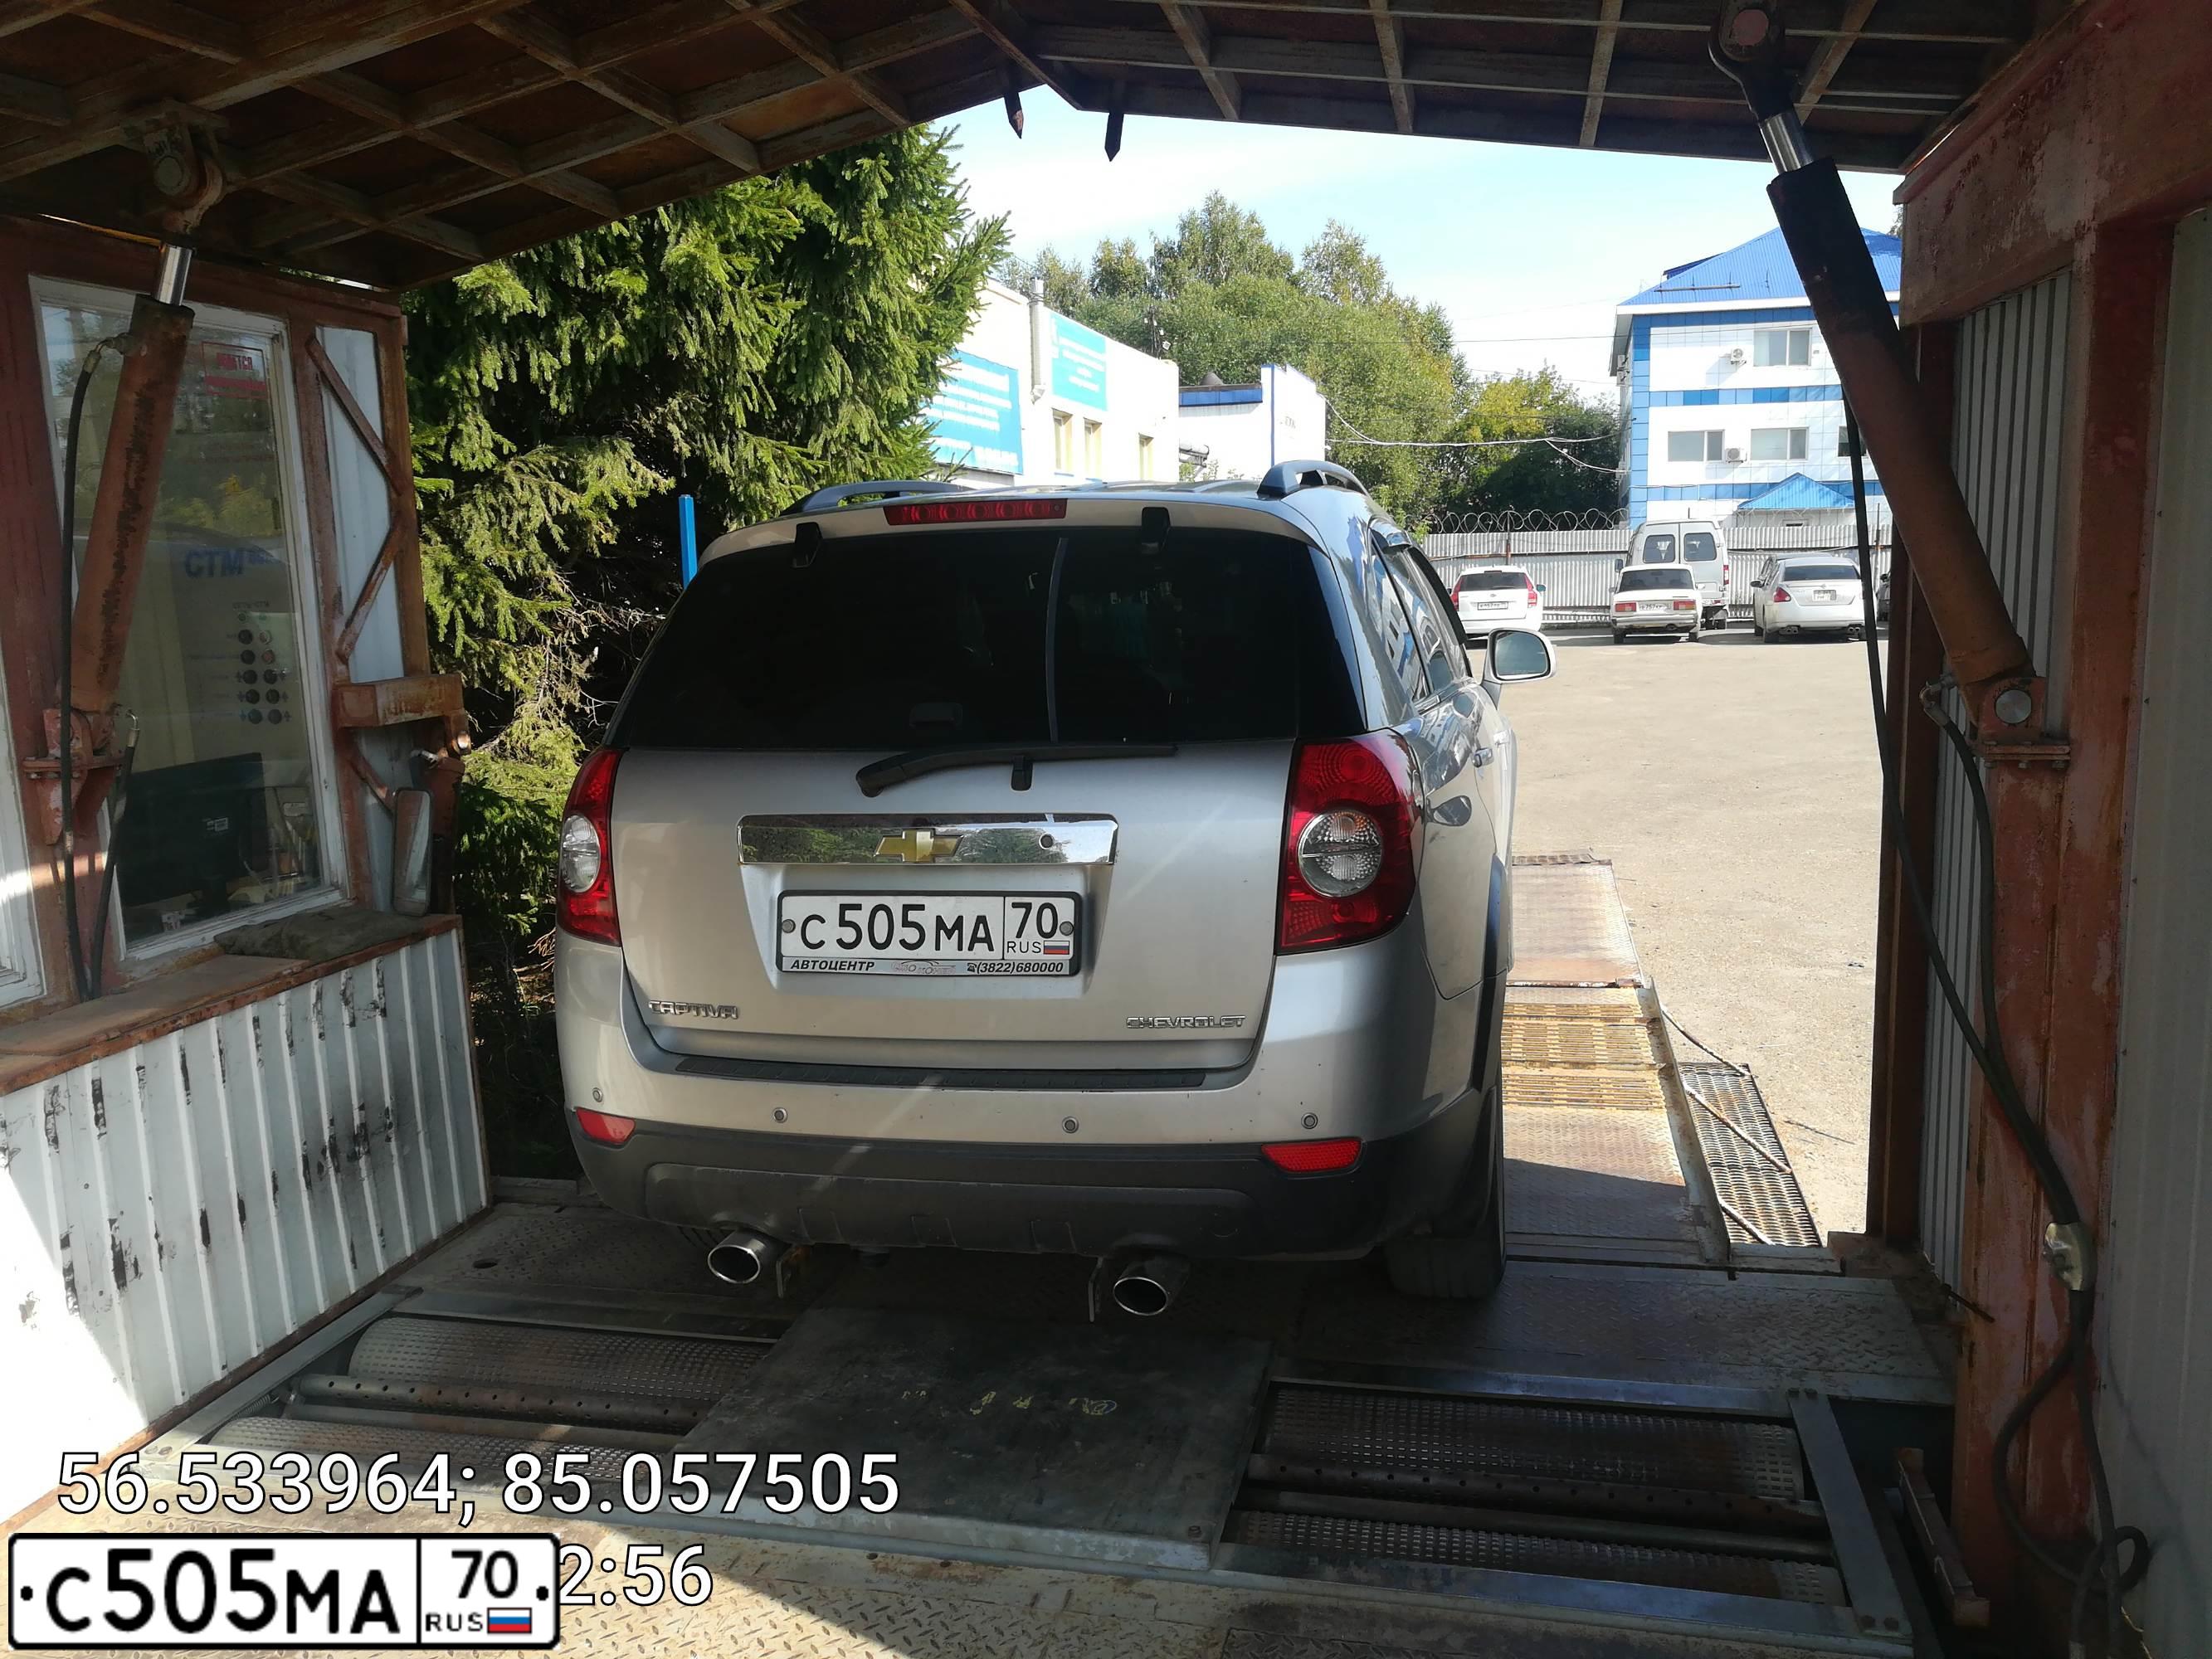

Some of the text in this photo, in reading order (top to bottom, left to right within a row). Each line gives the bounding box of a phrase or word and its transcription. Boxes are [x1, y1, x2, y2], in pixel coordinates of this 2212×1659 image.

[800, 902, 1059, 951] С505МА 70
[1006, 941, 1042, 955] RUS
[791, 960, 1064, 973] АВТОЦЕНТР (3822)680000
[648, 1000, 738, 1020] CAPTIVA
[1127, 1015, 1245, 1029] CHEVROLET
